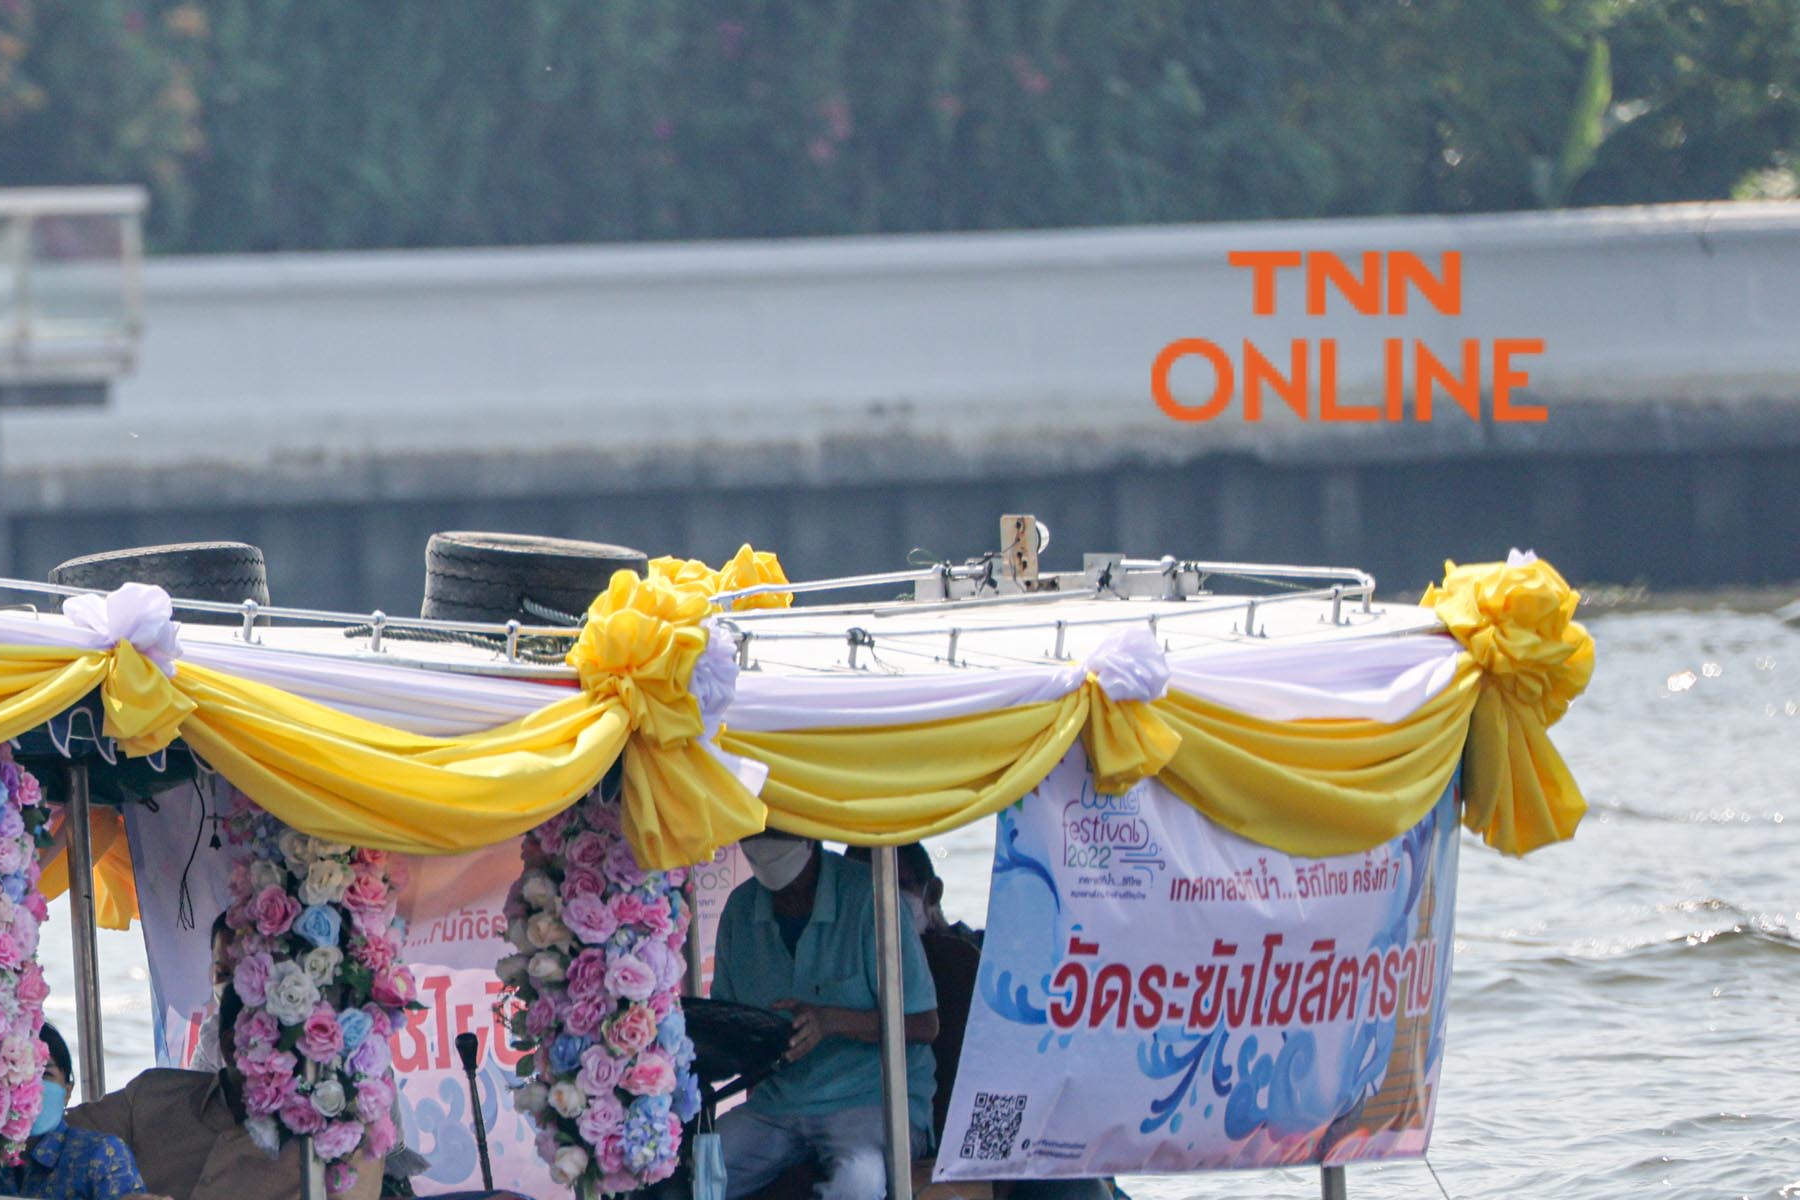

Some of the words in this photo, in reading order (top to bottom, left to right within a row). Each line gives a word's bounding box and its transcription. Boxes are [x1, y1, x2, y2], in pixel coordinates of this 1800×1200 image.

[1067, 843, 1112, 869] 2022
[1392, 860, 1401, 889] 7
[1050, 933, 1437, 1029] วัดระฆังโฆสิตาราม
